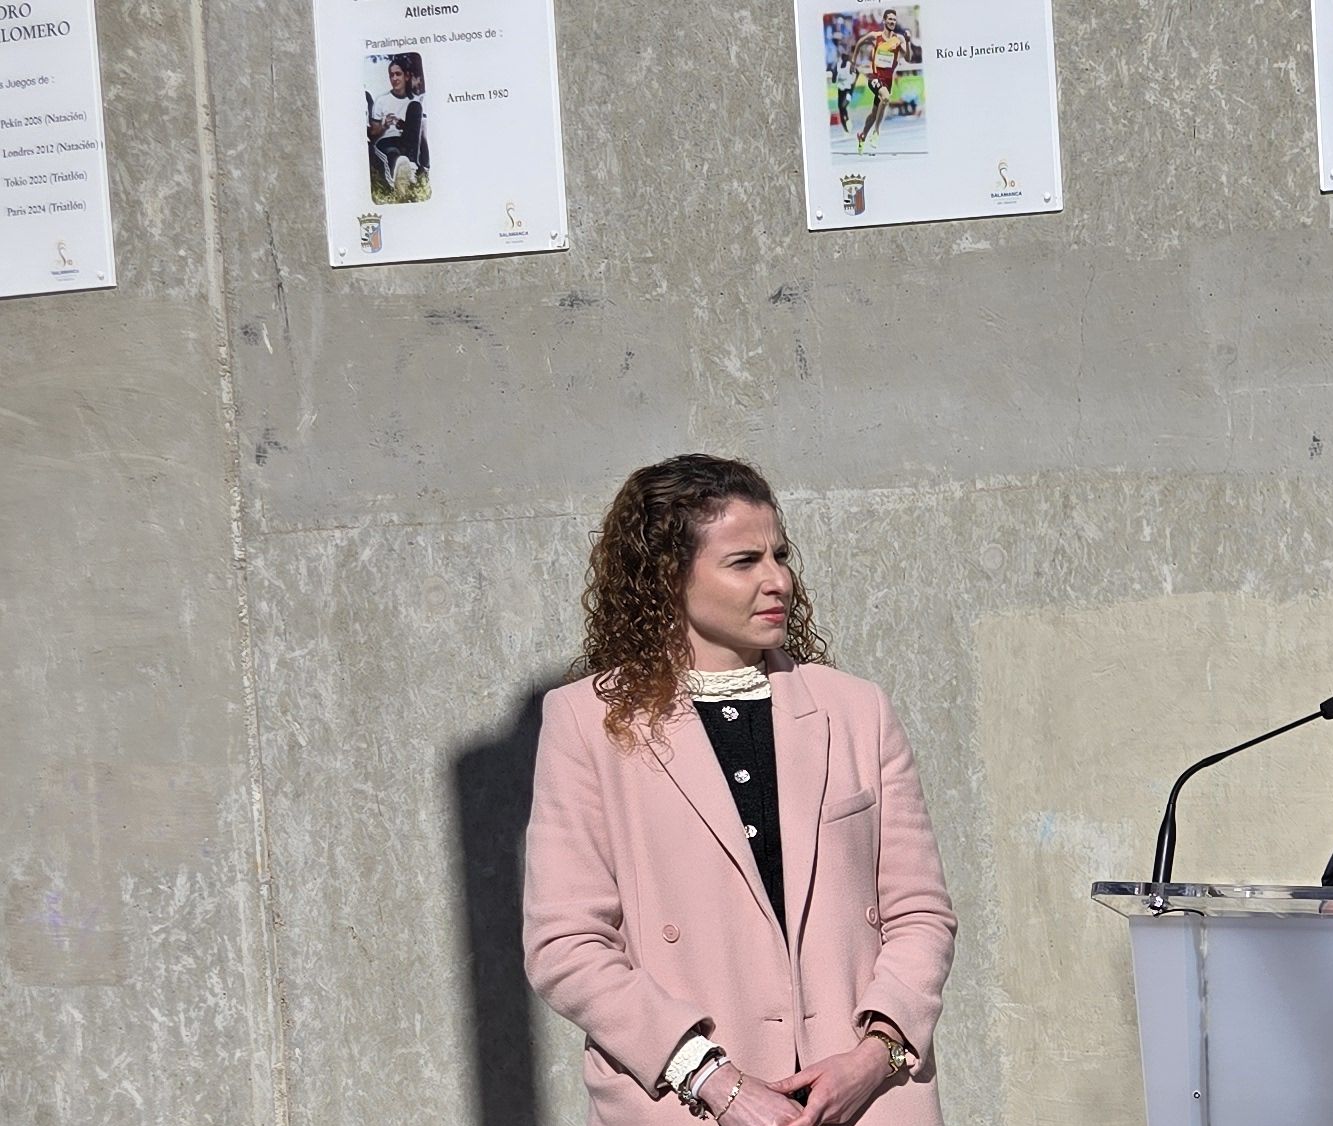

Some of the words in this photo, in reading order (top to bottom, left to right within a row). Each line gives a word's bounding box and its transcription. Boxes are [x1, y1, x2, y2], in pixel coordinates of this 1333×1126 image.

[404, 4, 461, 18] Atletismo
[420, 35, 431, 44] en
[433, 33, 447, 43] los
[449, 30, 483, 43] Juegos
[485, 28, 497, 38] de
[936, 48, 954, 59] Río
[956, 46, 968, 57] de
[969, 44, 1005, 58] Janeiro
[1007, 41, 1031, 53] 2016
[5, 78, 36, 89] Juegos
[38, 75, 49, 85] de
[447, 91, 485, 103] Arnhem
[45, 111, 87, 126] (Natación)
[3, 147, 34, 158] Londres
[36, 144, 54, 155] 2012
[56, 139, 99, 155] (Natación)
[4, 176, 28, 188] Tokio
[29, 175, 47, 185] 2020
[49, 170, 88, 185] (Triatlón)
[28, 204, 46, 215] 2024
[49, 199, 87, 215] (Triatlón)
